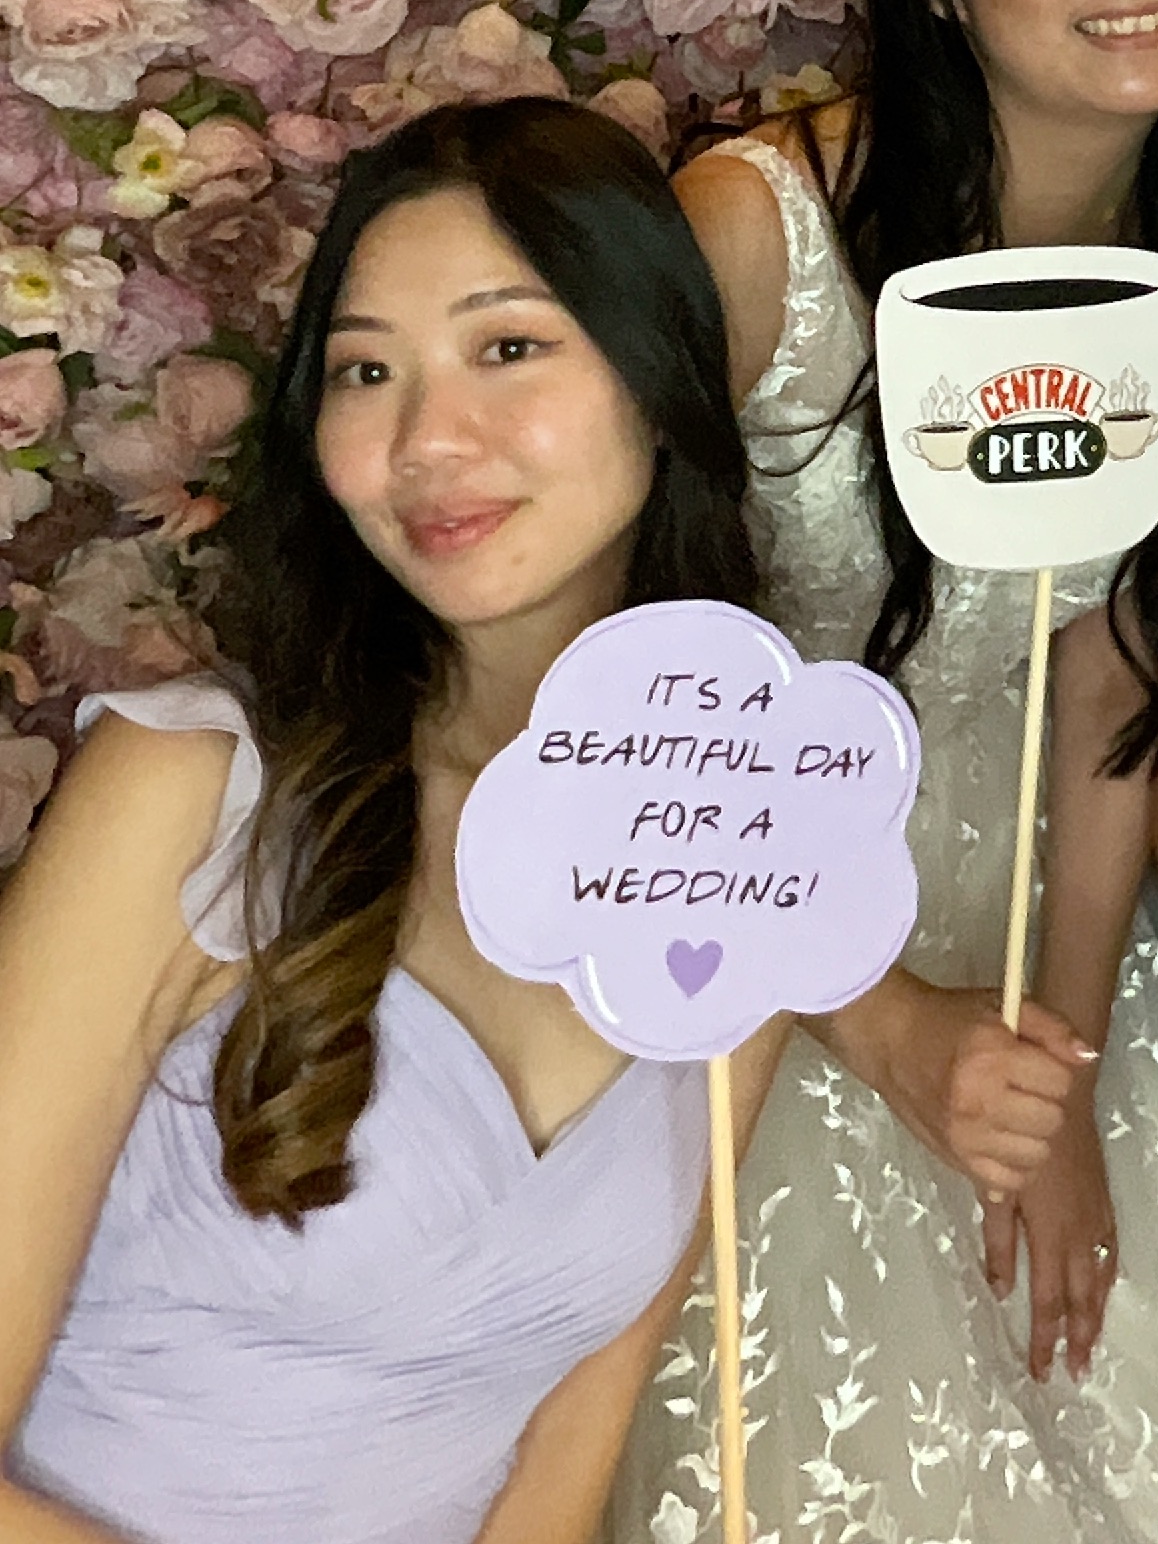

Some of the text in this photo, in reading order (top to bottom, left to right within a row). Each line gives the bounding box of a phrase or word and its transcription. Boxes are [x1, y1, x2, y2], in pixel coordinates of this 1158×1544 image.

[980, 368, 1092, 421] CENTRAL
[987, 429, 1089, 475] PERK
[738, 681, 774, 712] A
[538, 729, 874, 778] BEAUTIFUL DAY
[629, 800, 774, 843] FOR A
[571, 865, 820, 909] WEDDING!
